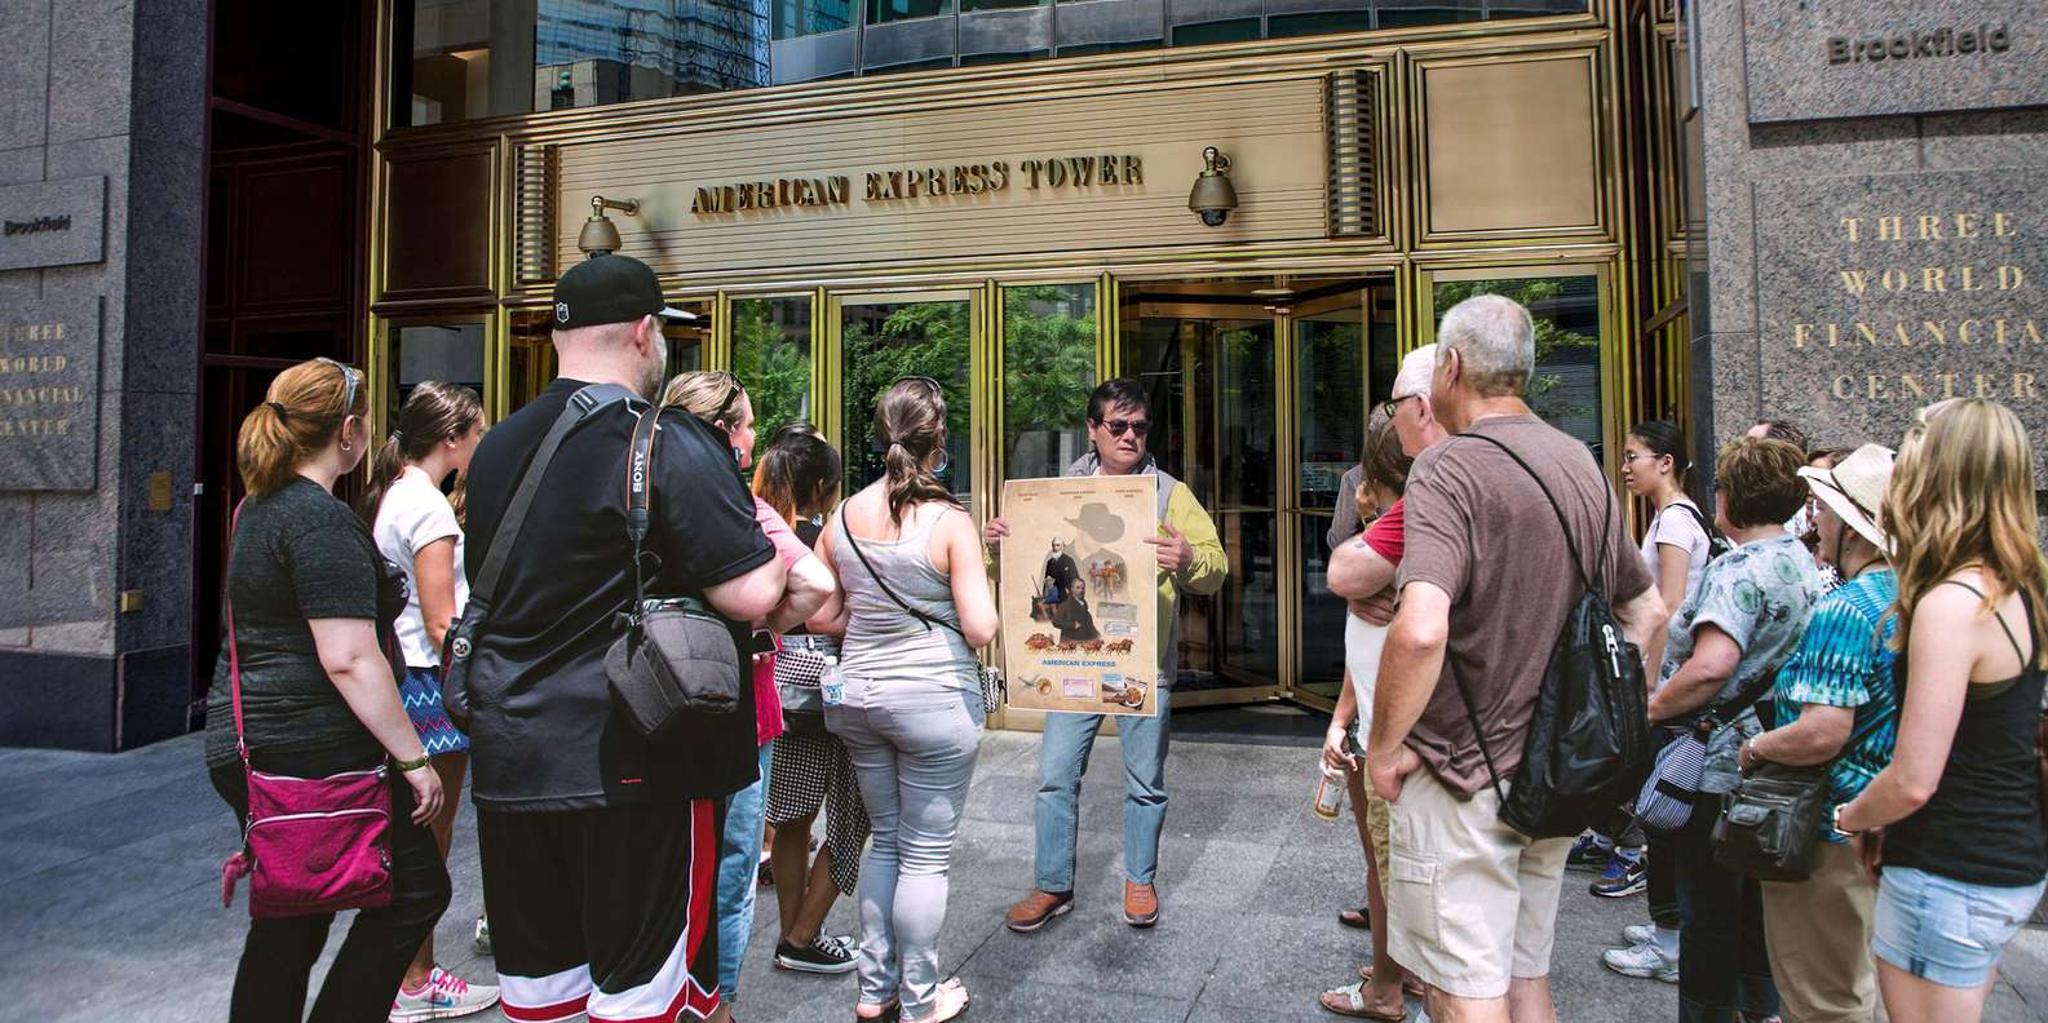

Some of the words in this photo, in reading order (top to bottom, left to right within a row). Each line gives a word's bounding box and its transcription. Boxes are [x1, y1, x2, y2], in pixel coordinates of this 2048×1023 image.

[1826, 22, 2011, 66] Brookfield
[690, 175, 850, 213] AMERICAN
[863, 160, 1011, 201] EXPRESS
[1020, 154, 1145, 190] TOWER
[4, 214, 71, 236] Brookfield
[1840, 211, 2018, 244] THREE
[1840, 264, 2024, 294] WORLD
[1832, 371, 2038, 400] CENTER
[0, 419, 69, 437] ENTER
[632, 451, 644, 493] SONY
